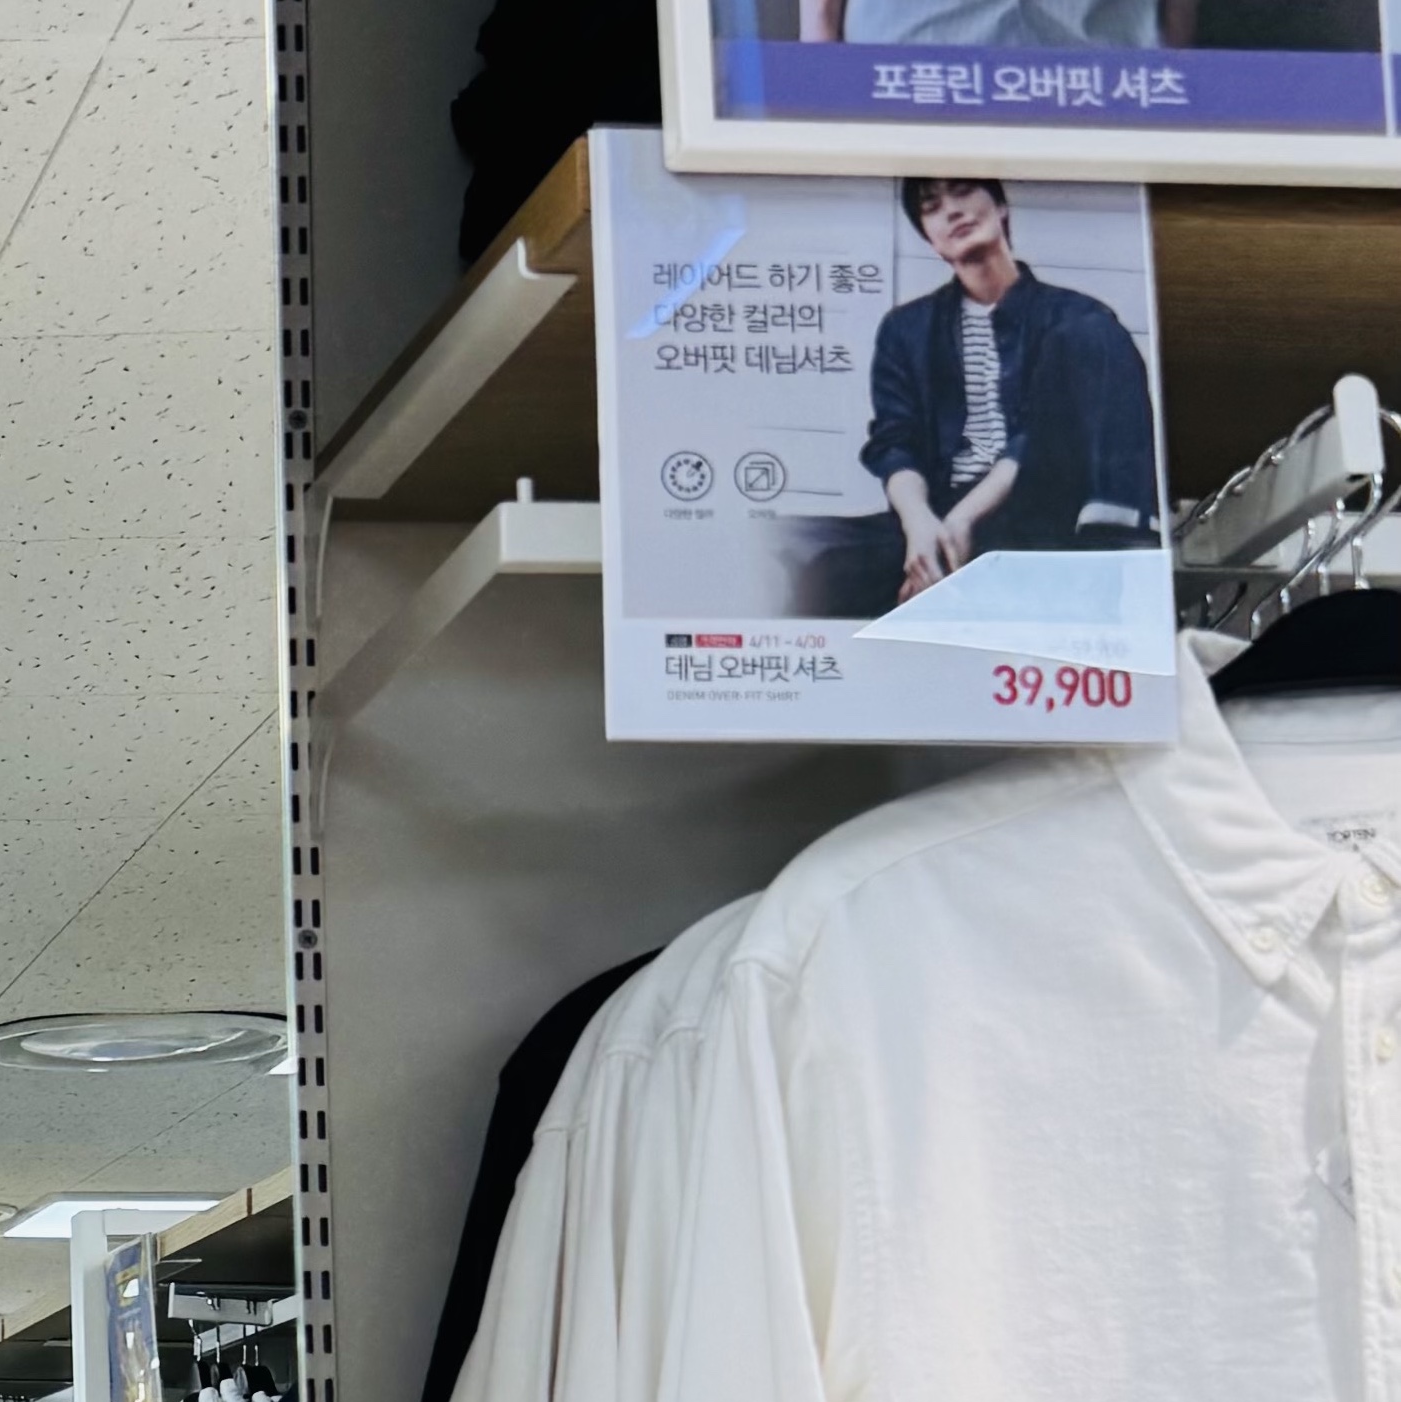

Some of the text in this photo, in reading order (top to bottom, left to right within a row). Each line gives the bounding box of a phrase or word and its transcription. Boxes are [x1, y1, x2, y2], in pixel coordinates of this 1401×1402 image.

[871, 62, 1190, 108] 포플린 오버핏 셔츠
[653, 262, 884, 294] 레이어드 하기 좋은
[653, 302, 824, 334] 다양한 컬러의
[654, 344, 854, 375] 오버핏 데님셔츠
[748, 635, 779, 649] 4/11
[795, 635, 826, 649] 4/30
[665, 654, 843, 683] 데님 오버핏 셔츠
[992, 664, 1133, 714] 39,900
